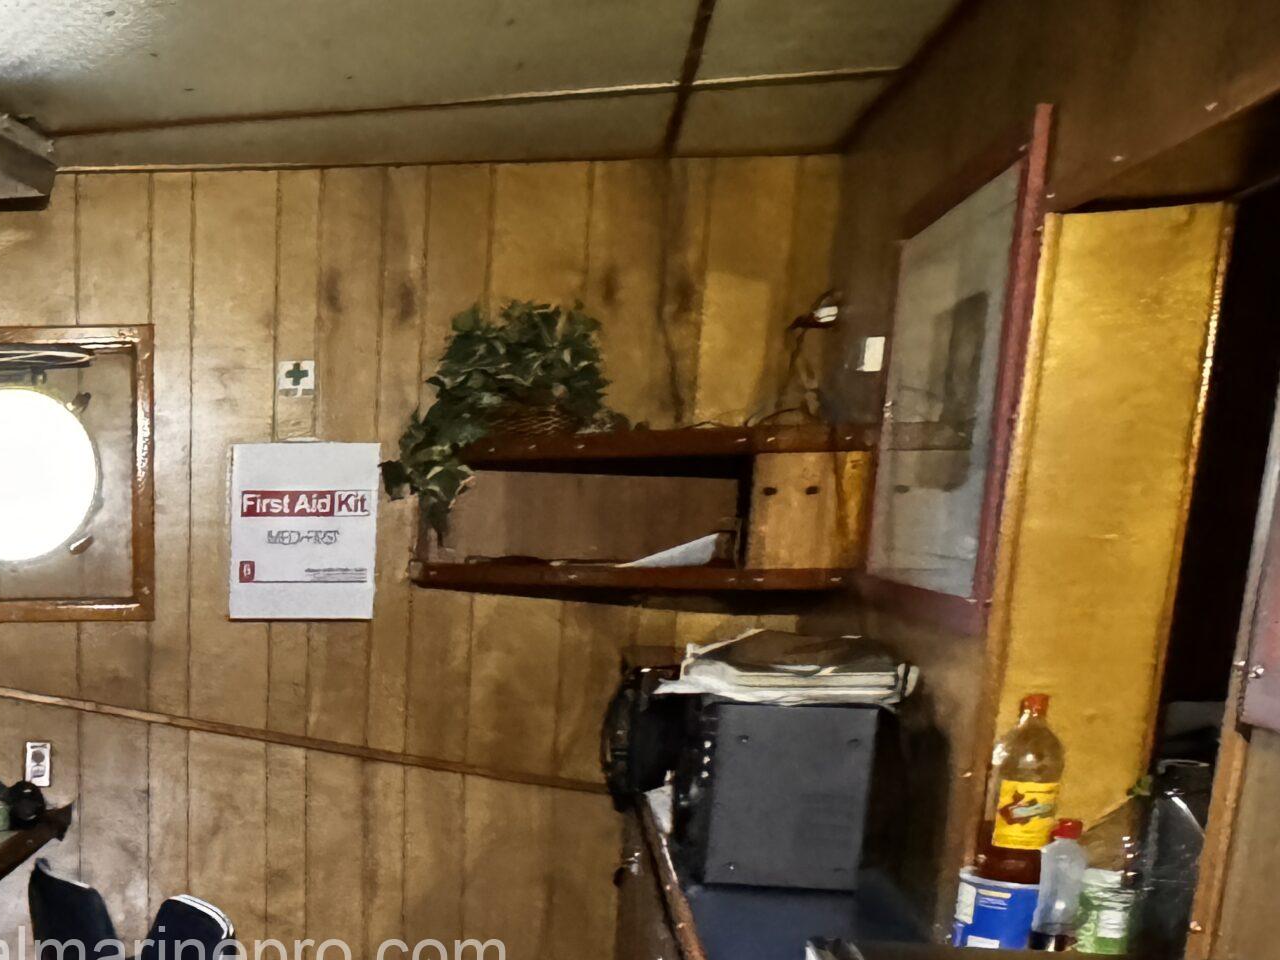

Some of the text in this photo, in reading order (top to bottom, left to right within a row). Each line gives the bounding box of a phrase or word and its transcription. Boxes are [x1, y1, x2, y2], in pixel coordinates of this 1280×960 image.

[242, 493, 368, 514] First Aid Kit
